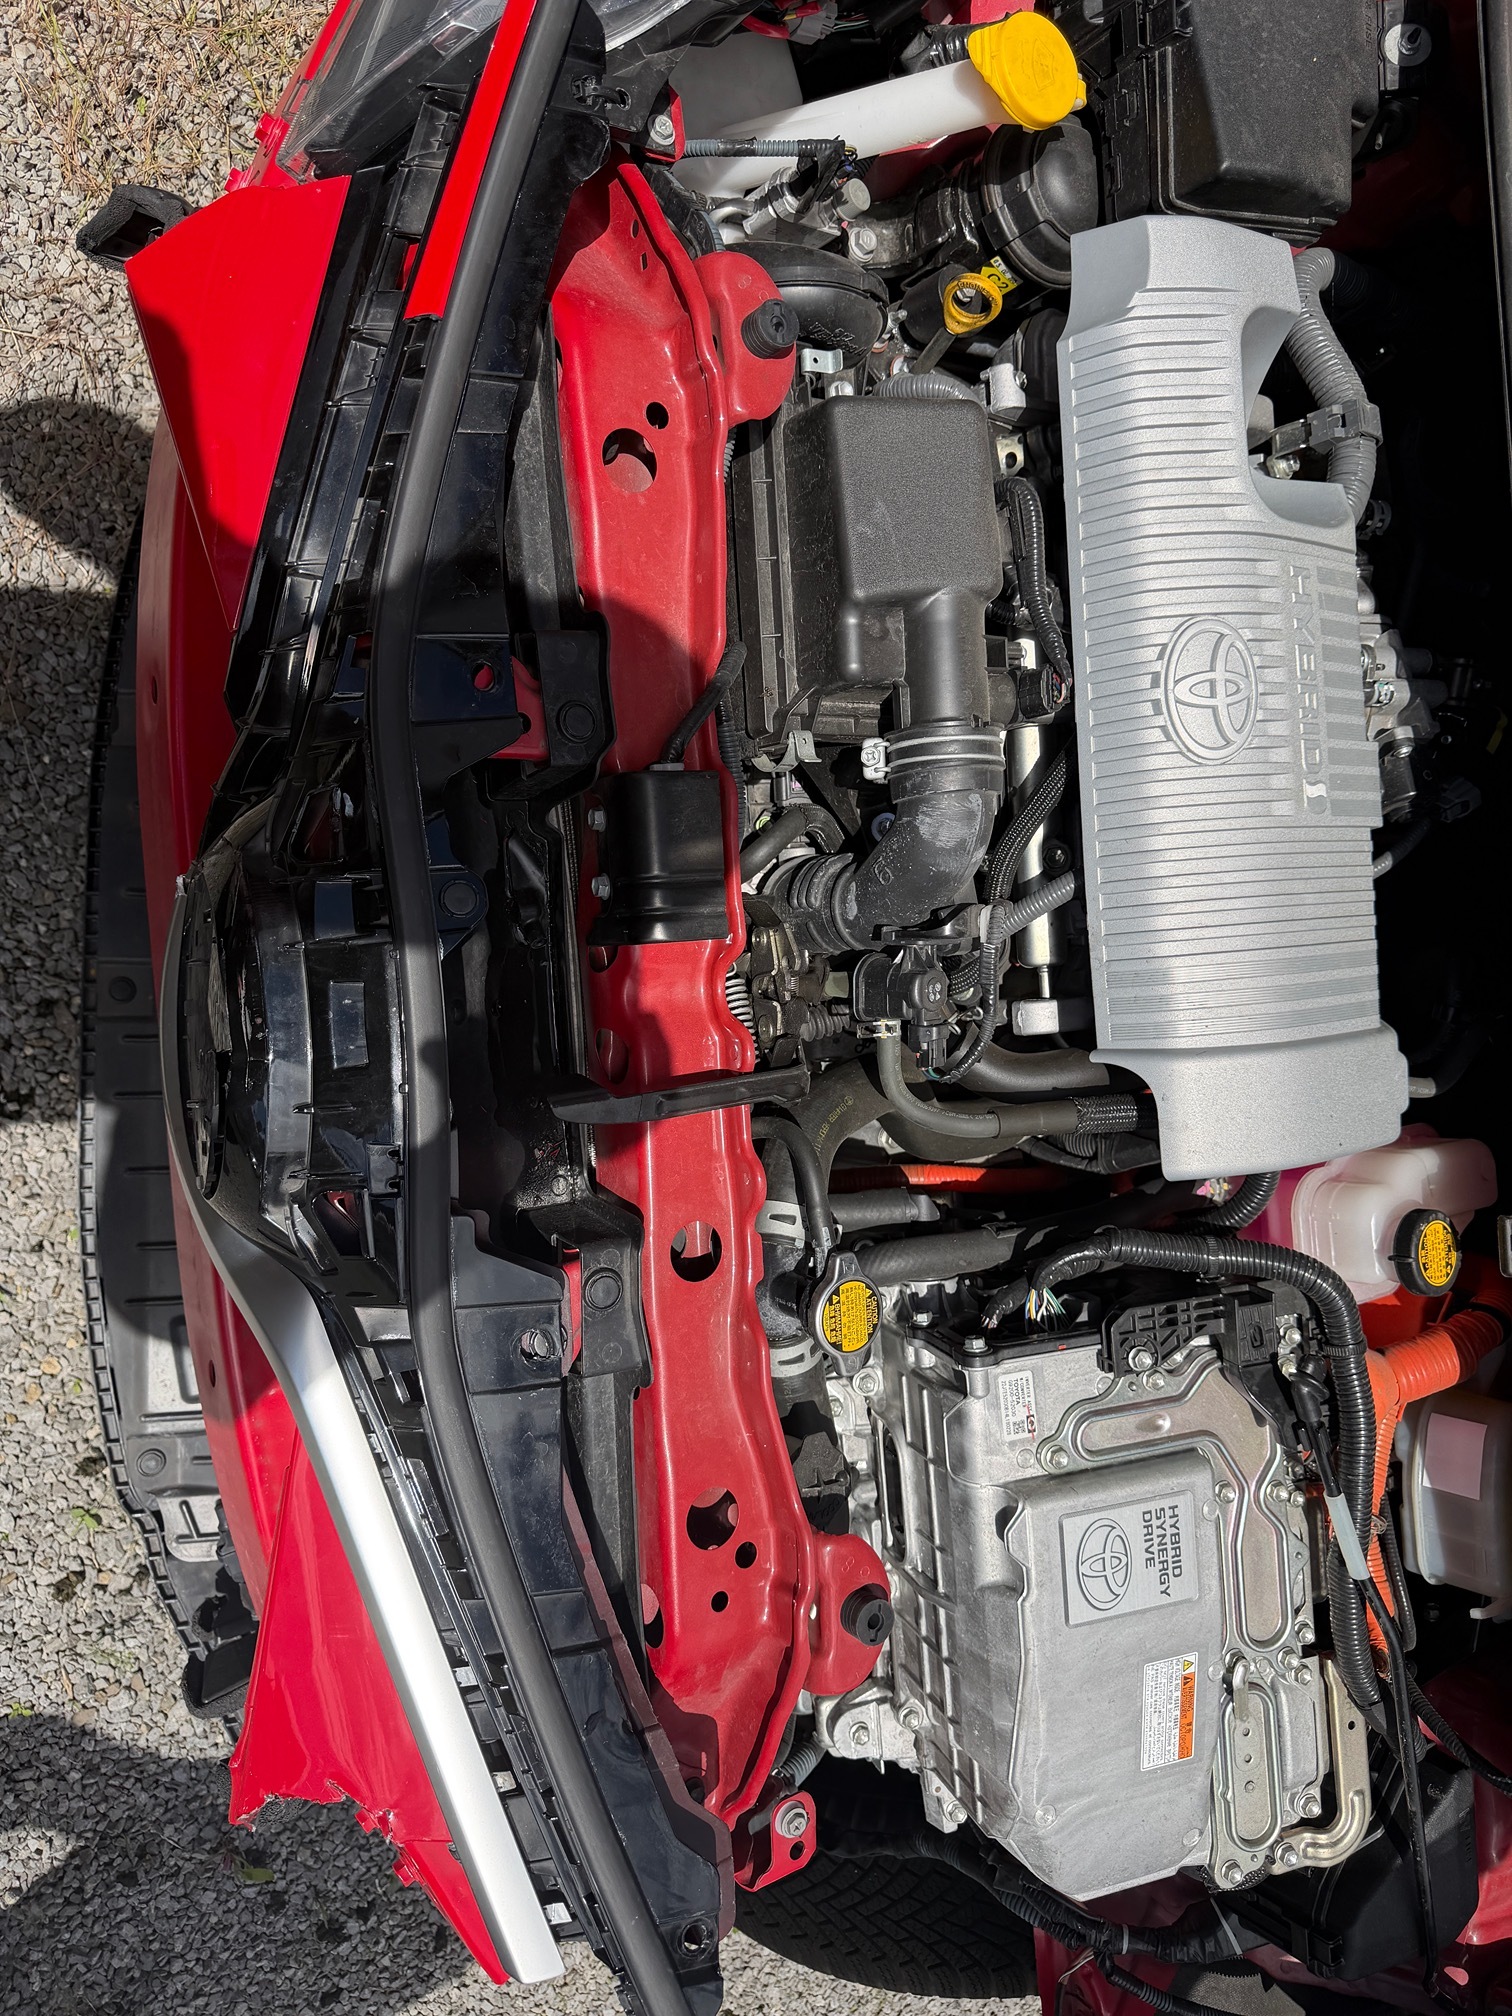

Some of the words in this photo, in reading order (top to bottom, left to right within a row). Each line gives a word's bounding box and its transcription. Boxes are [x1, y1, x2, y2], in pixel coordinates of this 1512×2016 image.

[1290, 565, 1321, 774] HYBRID
[1141, 1510, 1157, 1569] DRIVE
[1154, 1507, 1171, 1598] SYNERGY
[1167, 1505, 1183, 1578] HYBRID
